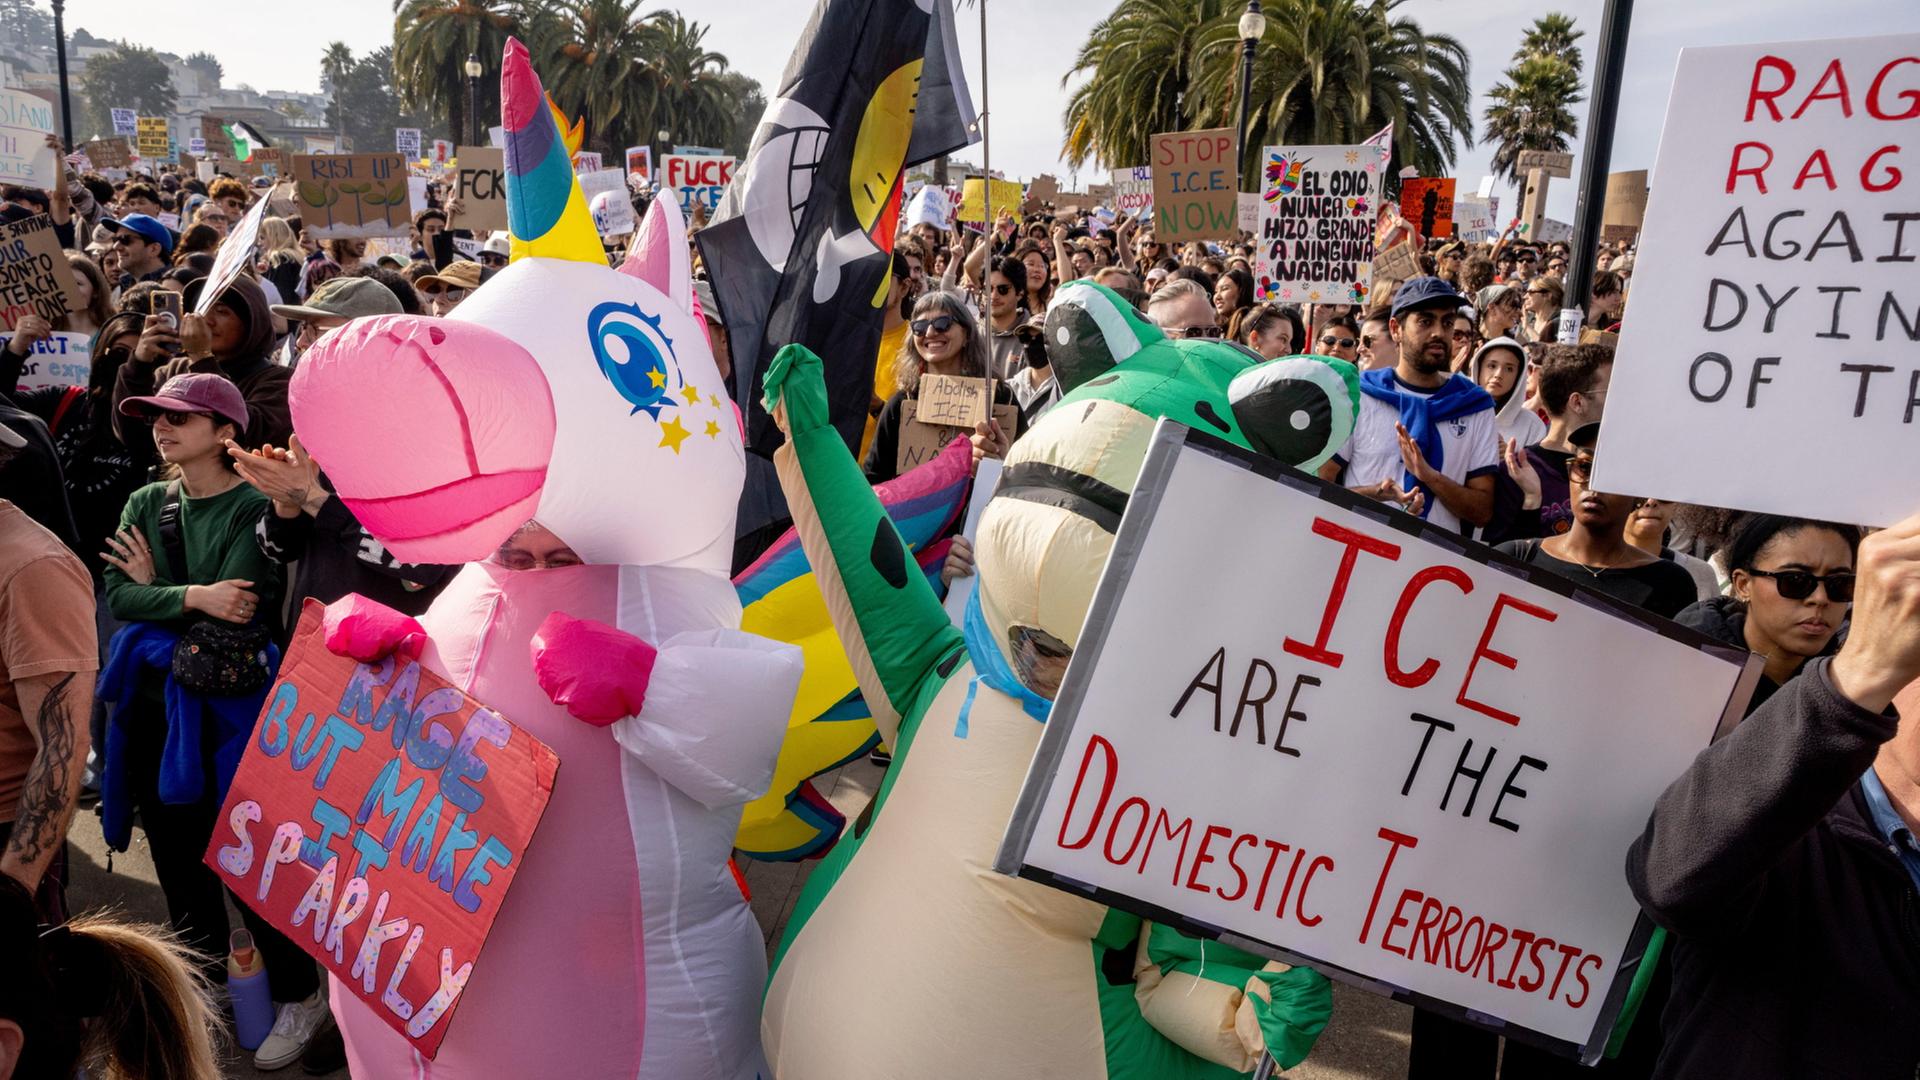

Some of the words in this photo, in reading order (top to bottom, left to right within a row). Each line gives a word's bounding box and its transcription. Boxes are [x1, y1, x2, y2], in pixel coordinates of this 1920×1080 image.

[1159, 137, 1231, 166] STOP
[311, 159, 361, 179] RISE
[372, 158, 400, 180] UP
[668, 158, 733, 188] FUCK
[1725, 141, 1902, 195] RAG
[459, 169, 506, 200] FCK
[1302, 174, 1325, 197] EL
[1330, 170, 1368, 196] ODIO
[1160, 202, 1237, 235] NOW
[1280, 197, 1343, 218] NUNCA
[8, 214, 53, 238] SKIPPING
[1264, 218, 1309, 239] HIZO
[1316, 218, 1376, 241] GRANDE
[1470, 219, 1486, 228] ICE
[1270, 240, 1287, 260] A
[1295, 240, 1374, 262] NINGUNA
[0, 273, 59, 306] TEACH
[36, 291, 73, 321] ONE
[933, 378, 978, 399] Abolish
[1689, 351, 1781, 408] OF
[931, 400, 971, 420] ICE
[1282, 517, 1558, 726] ICE
[337, 655, 512, 813] RAGE
[1170, 646, 1322, 758] ARE
[1401, 713, 1548, 833] THE
[258, 682, 366, 790] BUT
[356, 758, 514, 913] MAKE
[298, 797, 390, 879] IT
[1056, 735, 1335, 928] DOMESTIC
[1359, 827, 1603, 1010] TERRORISTS
[217, 801, 473, 1038] SPARKLY
